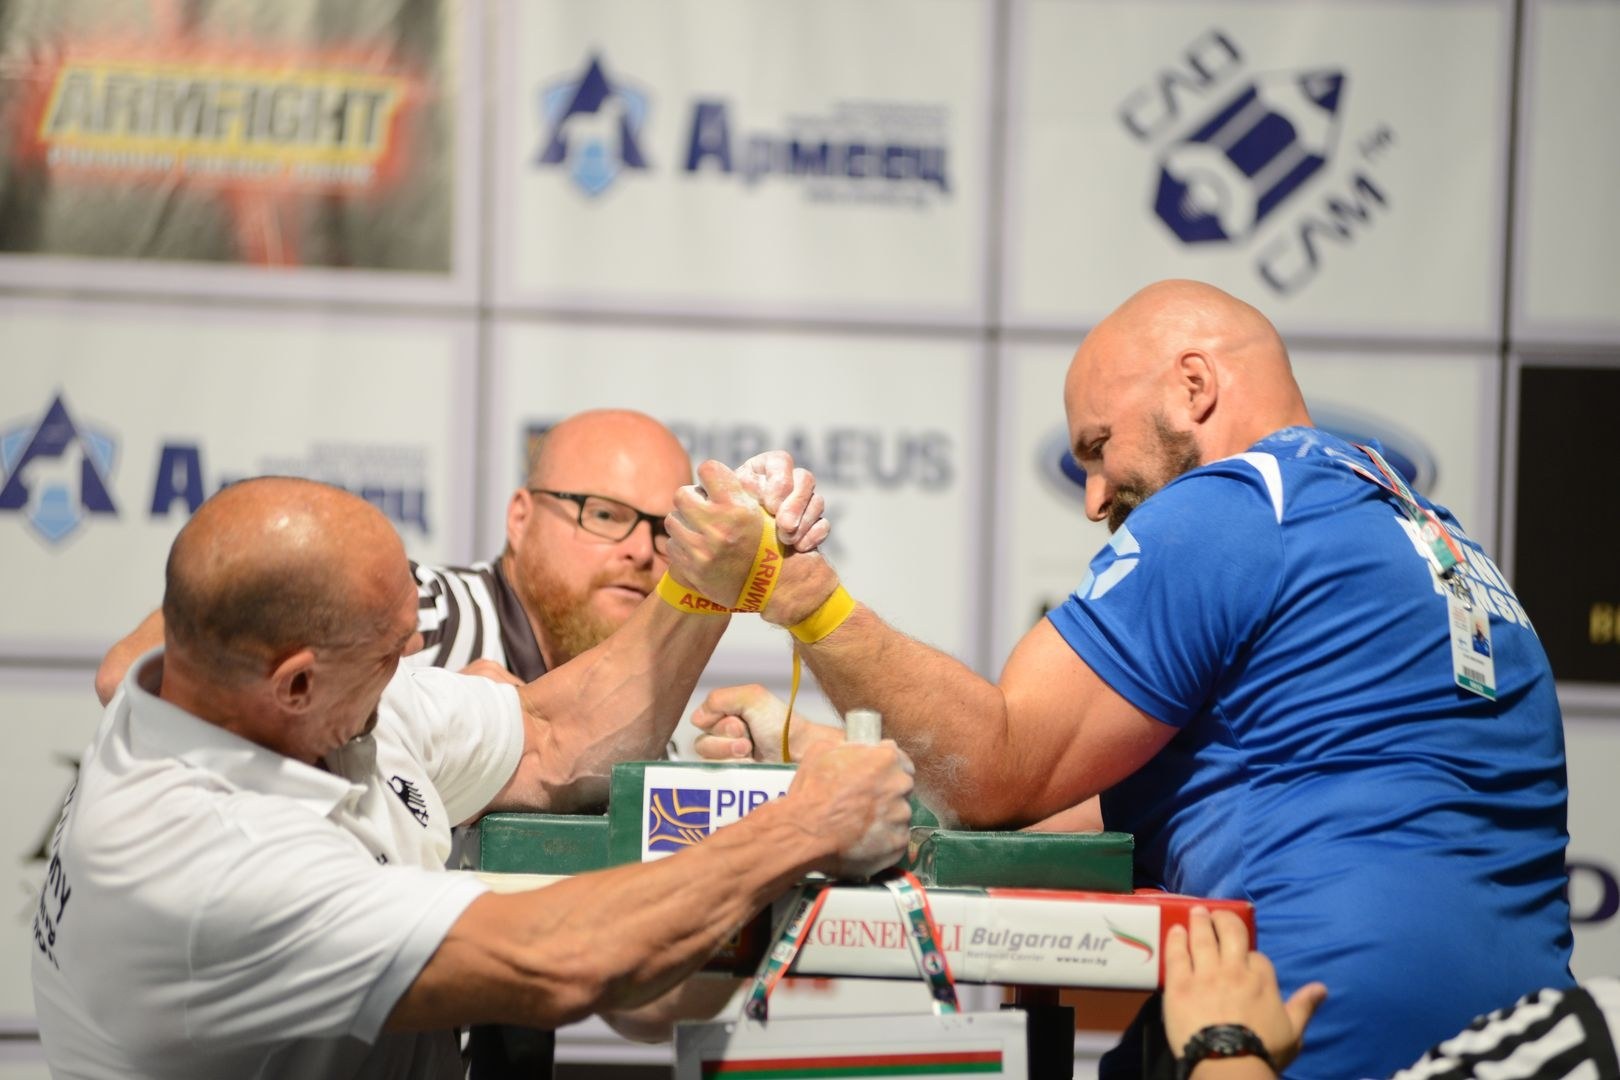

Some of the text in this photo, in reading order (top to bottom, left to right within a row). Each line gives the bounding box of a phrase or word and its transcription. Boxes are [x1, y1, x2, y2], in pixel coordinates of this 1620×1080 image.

[716, 789, 787, 818] PIR
[970, 927, 1112, 951] Bulgaria Air
